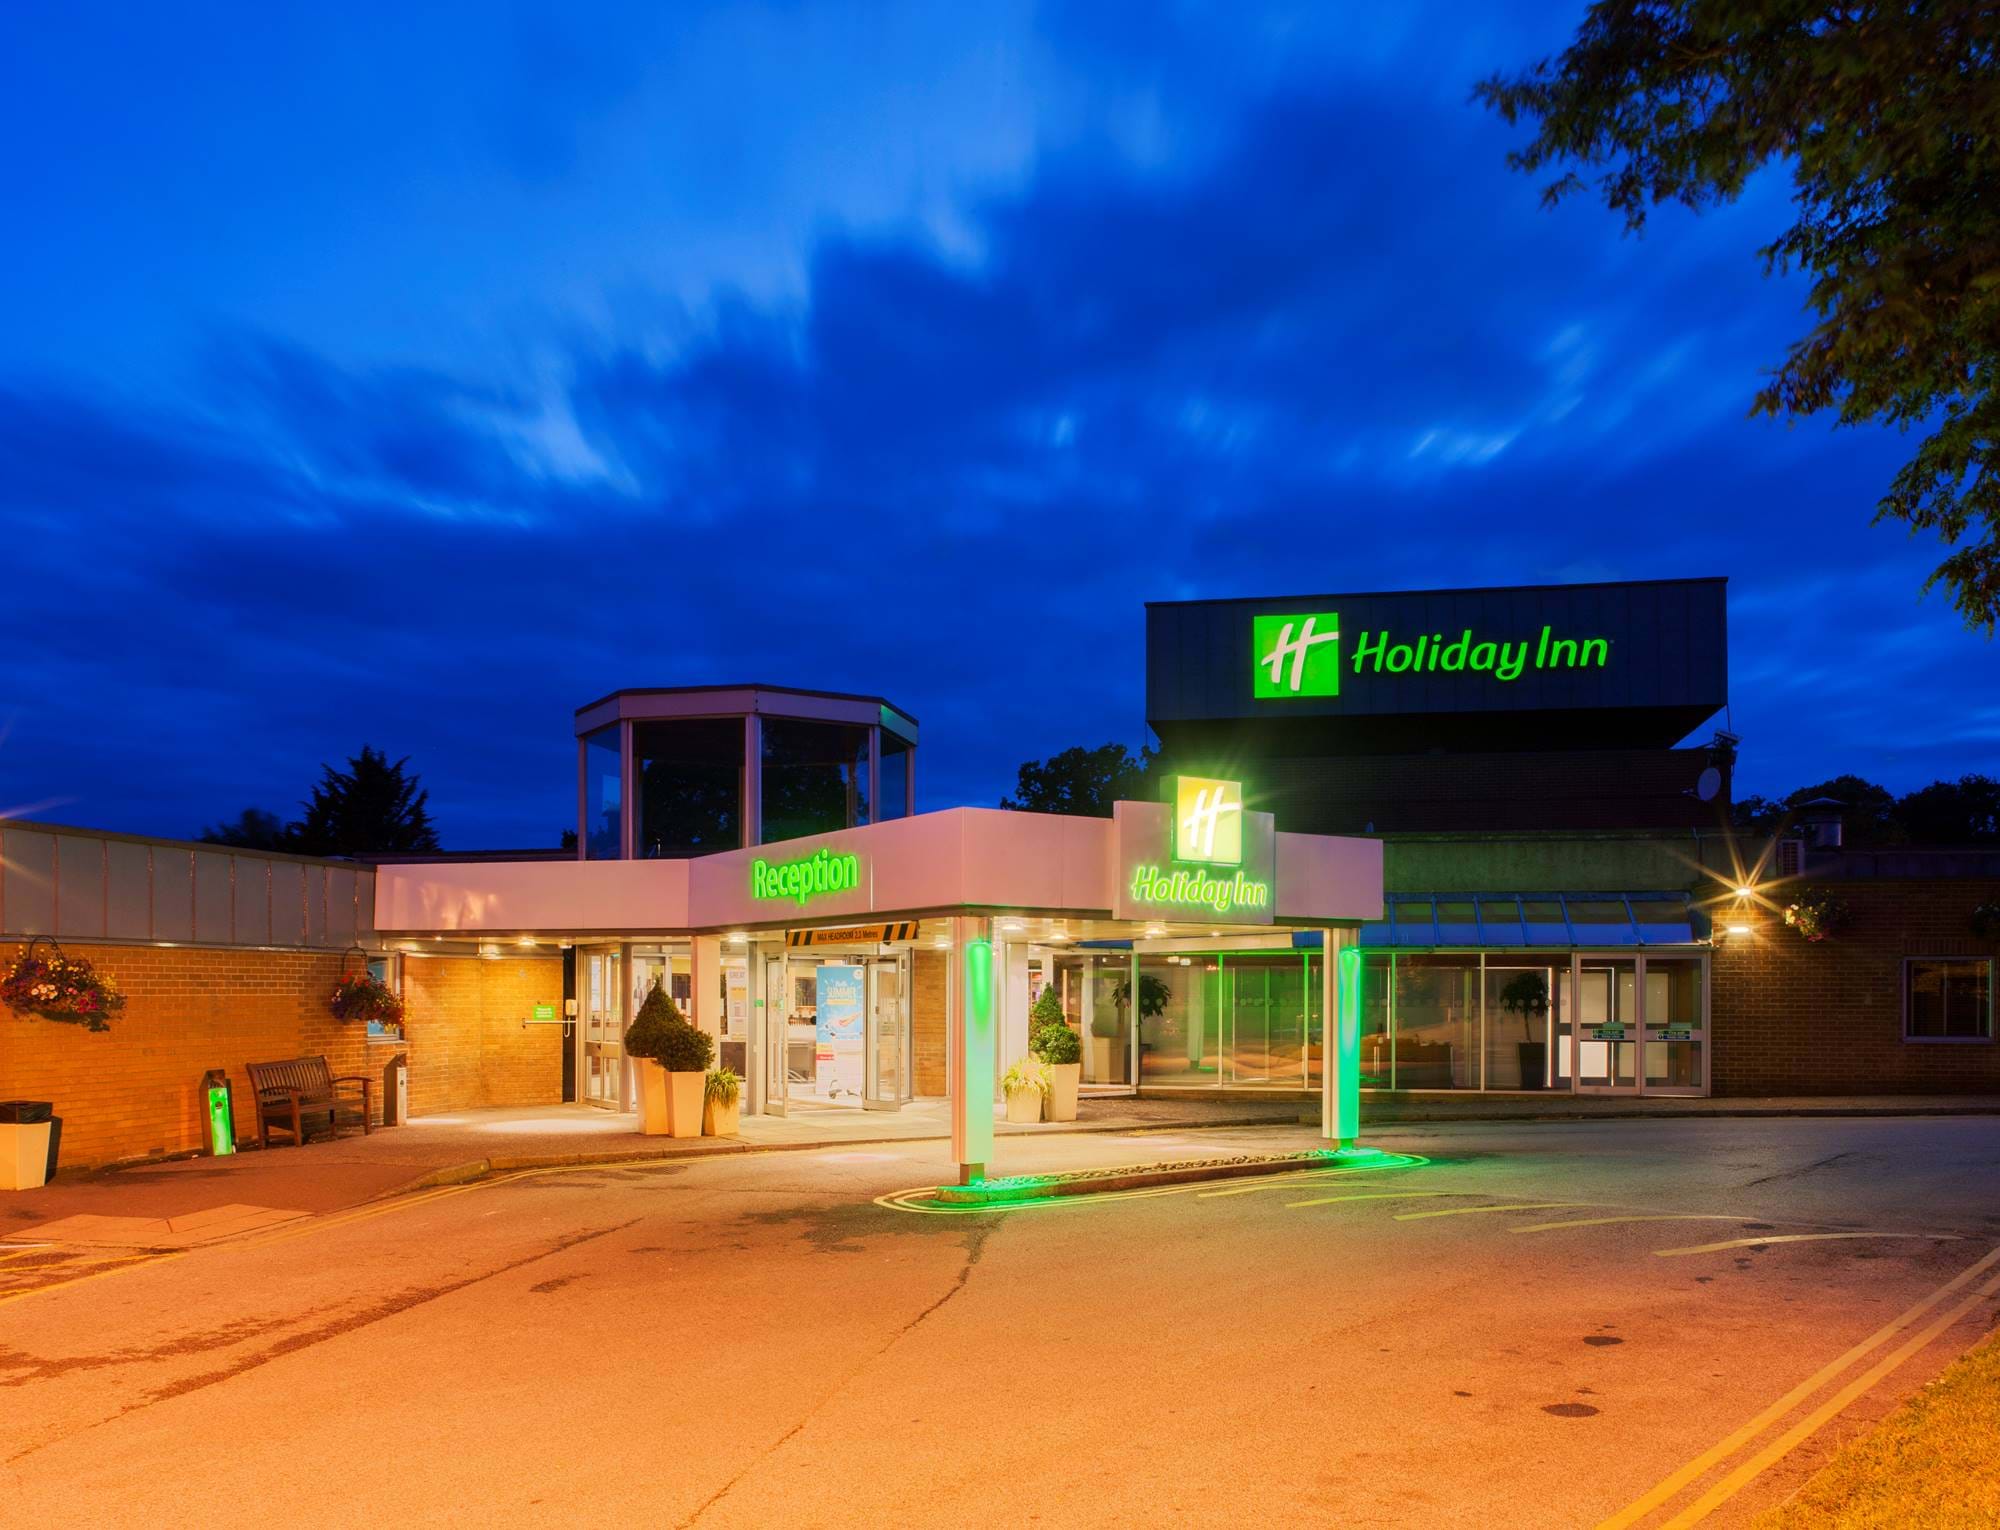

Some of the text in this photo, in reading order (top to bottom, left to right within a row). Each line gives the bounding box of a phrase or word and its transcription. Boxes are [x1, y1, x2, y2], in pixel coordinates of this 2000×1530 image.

[1351, 626, 1609, 681] Holiday Inn
[754, 848, 858, 905] Reception
[1131, 865, 1267, 911] Holiday Inn
